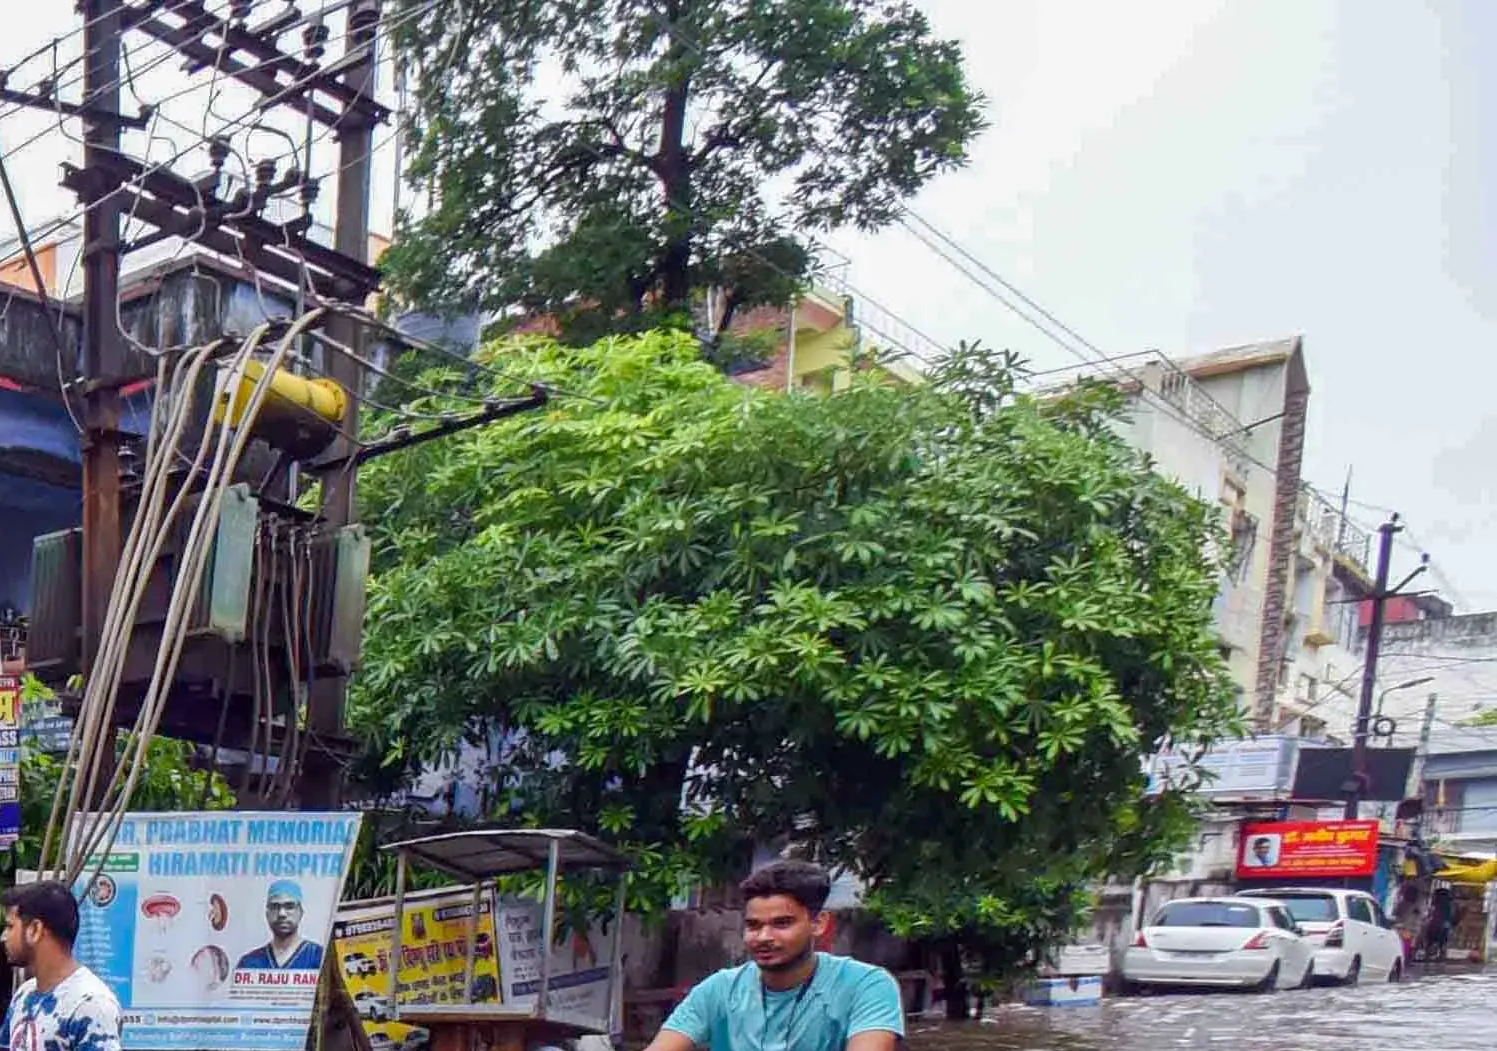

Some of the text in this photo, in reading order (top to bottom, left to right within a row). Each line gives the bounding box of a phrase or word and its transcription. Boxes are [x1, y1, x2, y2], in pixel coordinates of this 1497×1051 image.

[145, 819, 243, 845] PRABHAT
[148, 852, 249, 876] HIRAMATI
[255, 852, 344, 877] HOSPITA
[234, 972, 254, 984] DR.
[259, 973, 289, 984] RAJU
